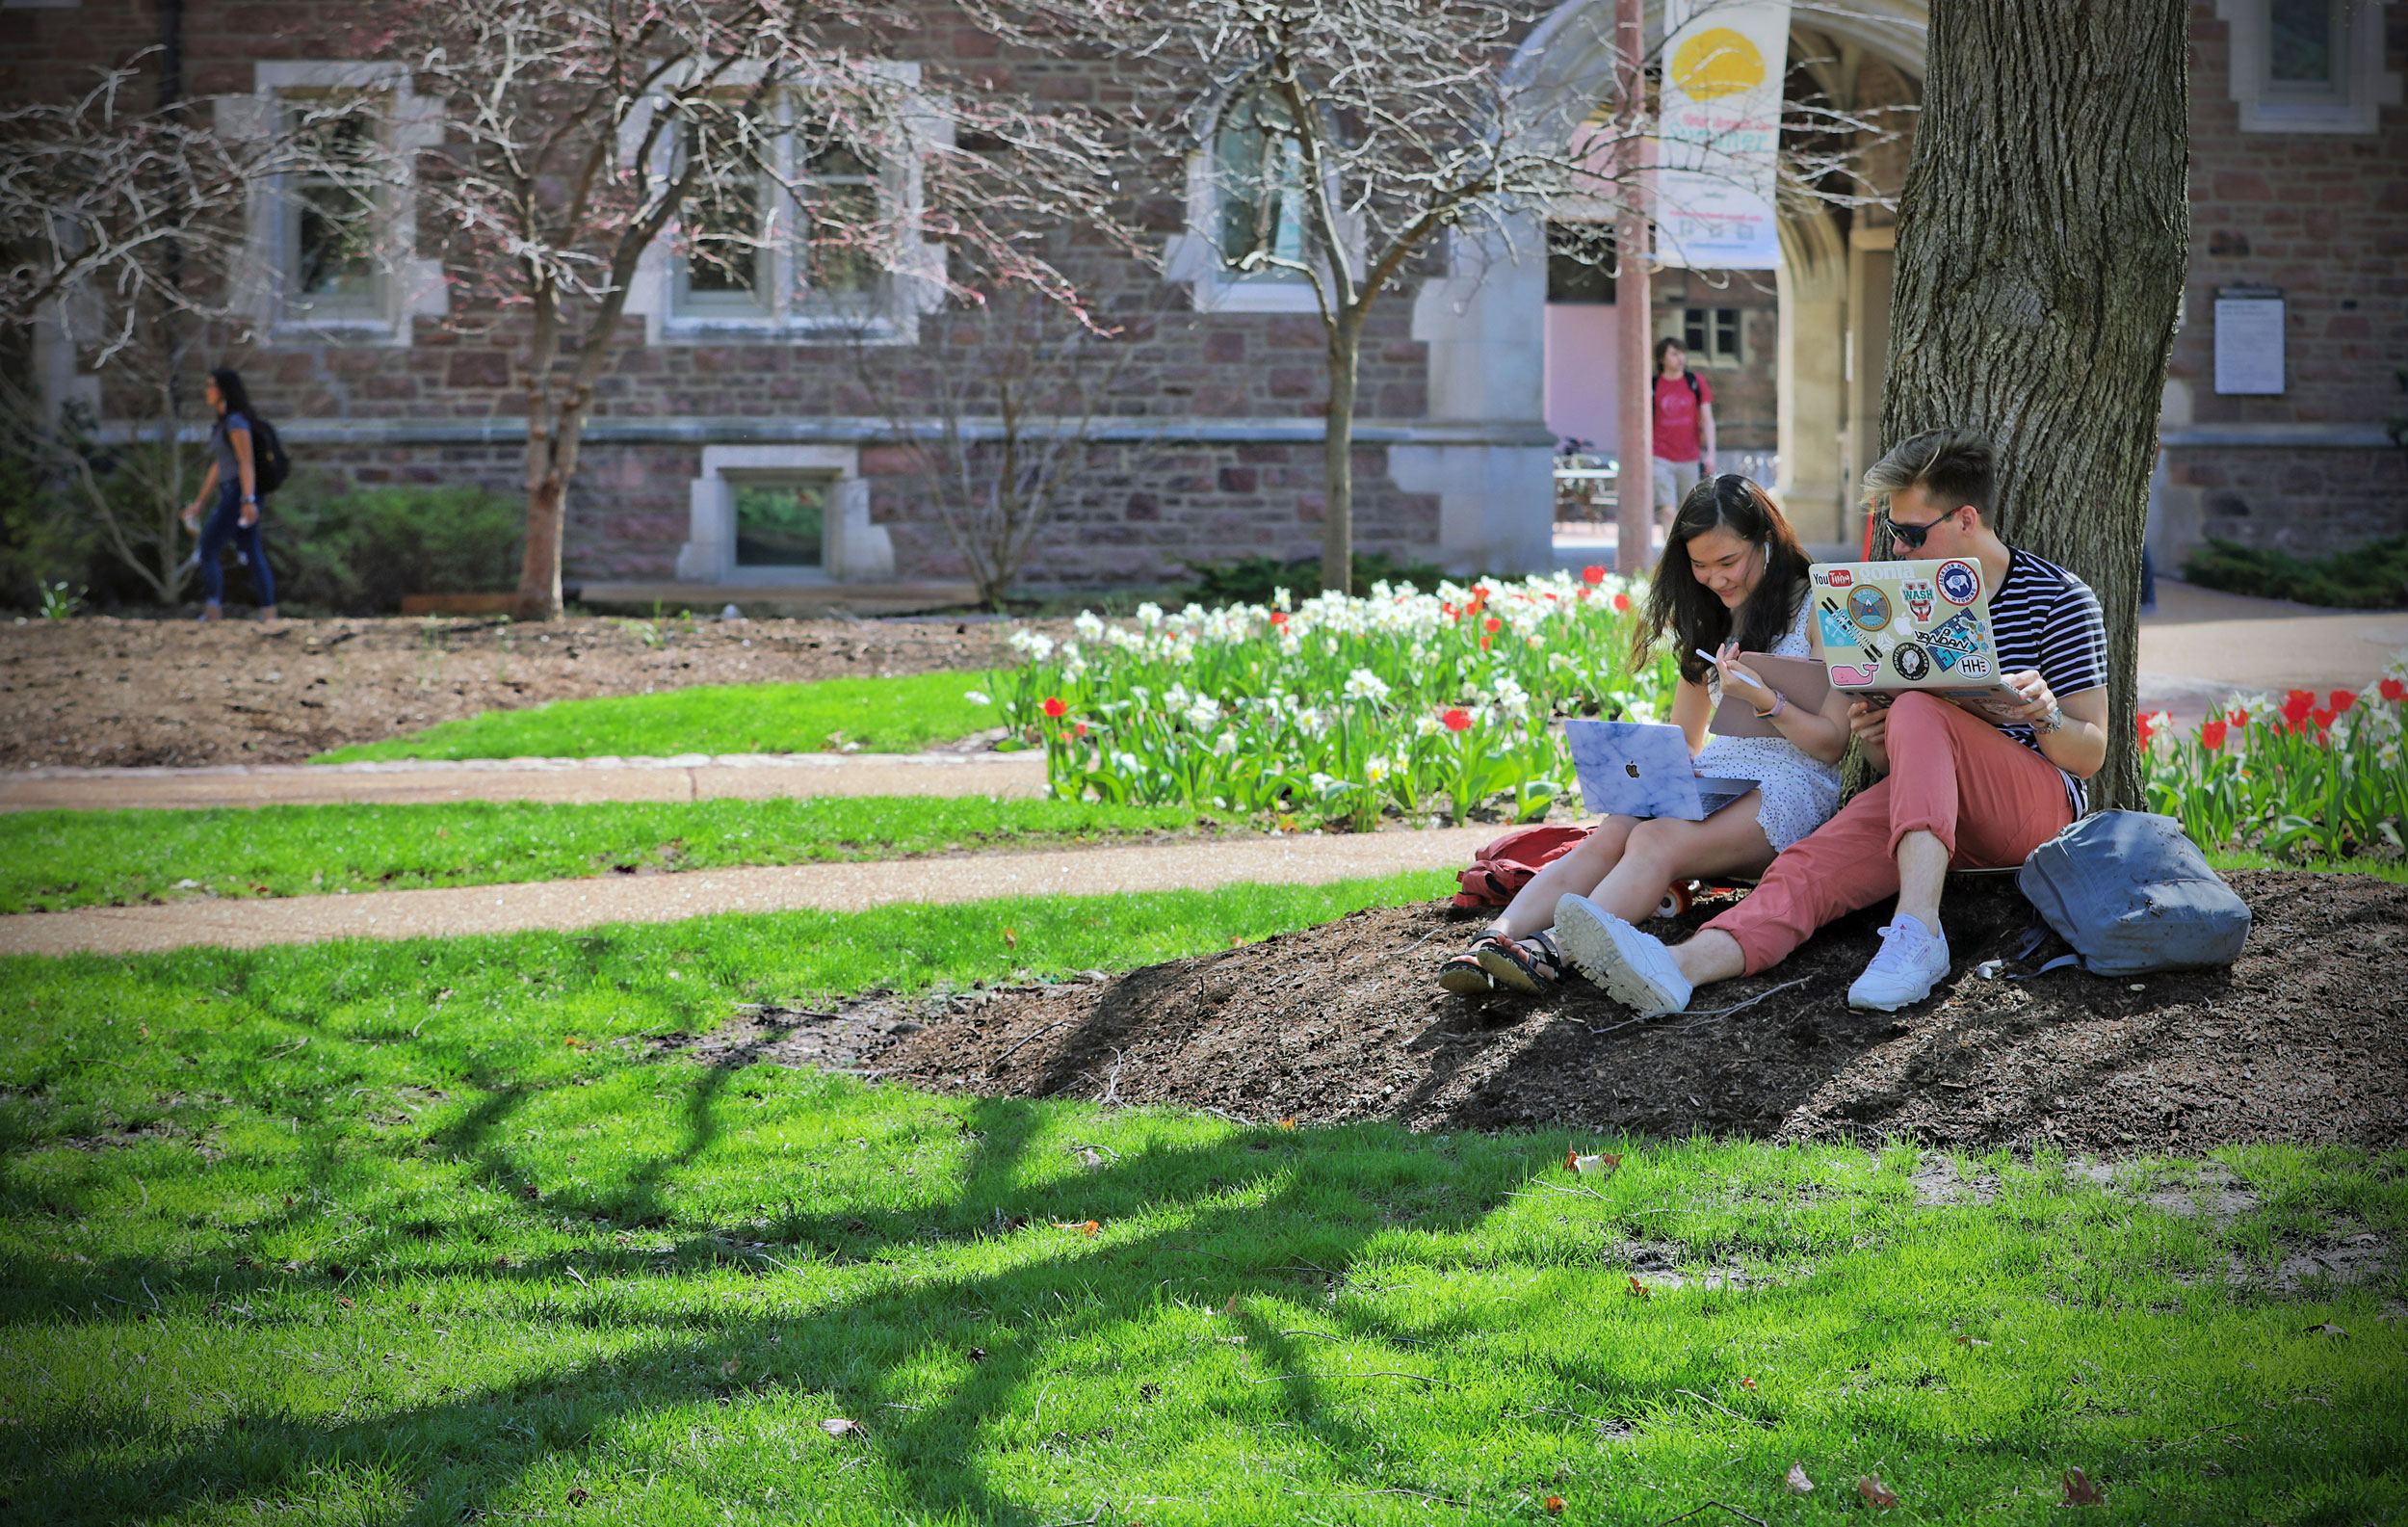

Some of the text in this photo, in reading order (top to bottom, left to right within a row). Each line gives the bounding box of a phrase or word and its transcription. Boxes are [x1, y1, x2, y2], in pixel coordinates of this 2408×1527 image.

[1939, 564, 1972, 586] JACKSON HOLE
[1903, 590, 1933, 600] WASH
[1951, 589, 1976, 602] WYOMING
[1894, 645, 1909, 669] HOMETOWN
